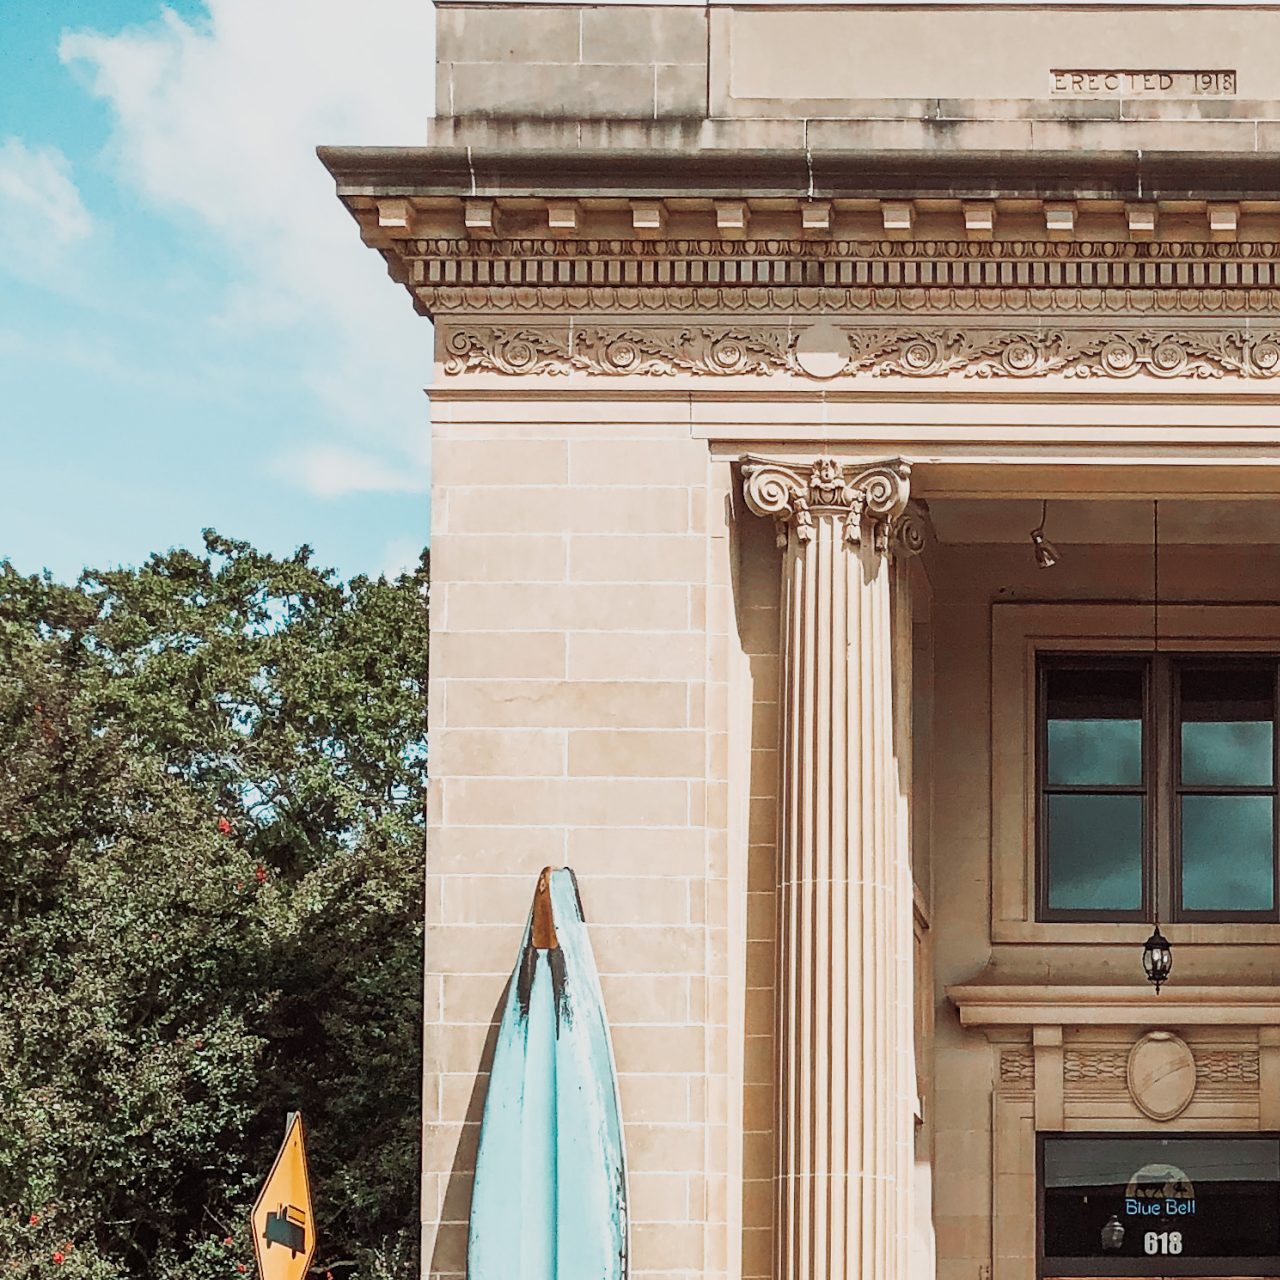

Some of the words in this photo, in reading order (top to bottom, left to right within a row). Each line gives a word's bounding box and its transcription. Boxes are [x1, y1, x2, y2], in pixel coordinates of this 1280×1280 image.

[1054, 74, 1174, 91] ERECTED
[1194, 74, 1233, 91] 1918
[1125, 1199, 1160, 1215] Blue
[1165, 1199, 1195, 1215] Bell
[1144, 1231, 1183, 1255] 618
